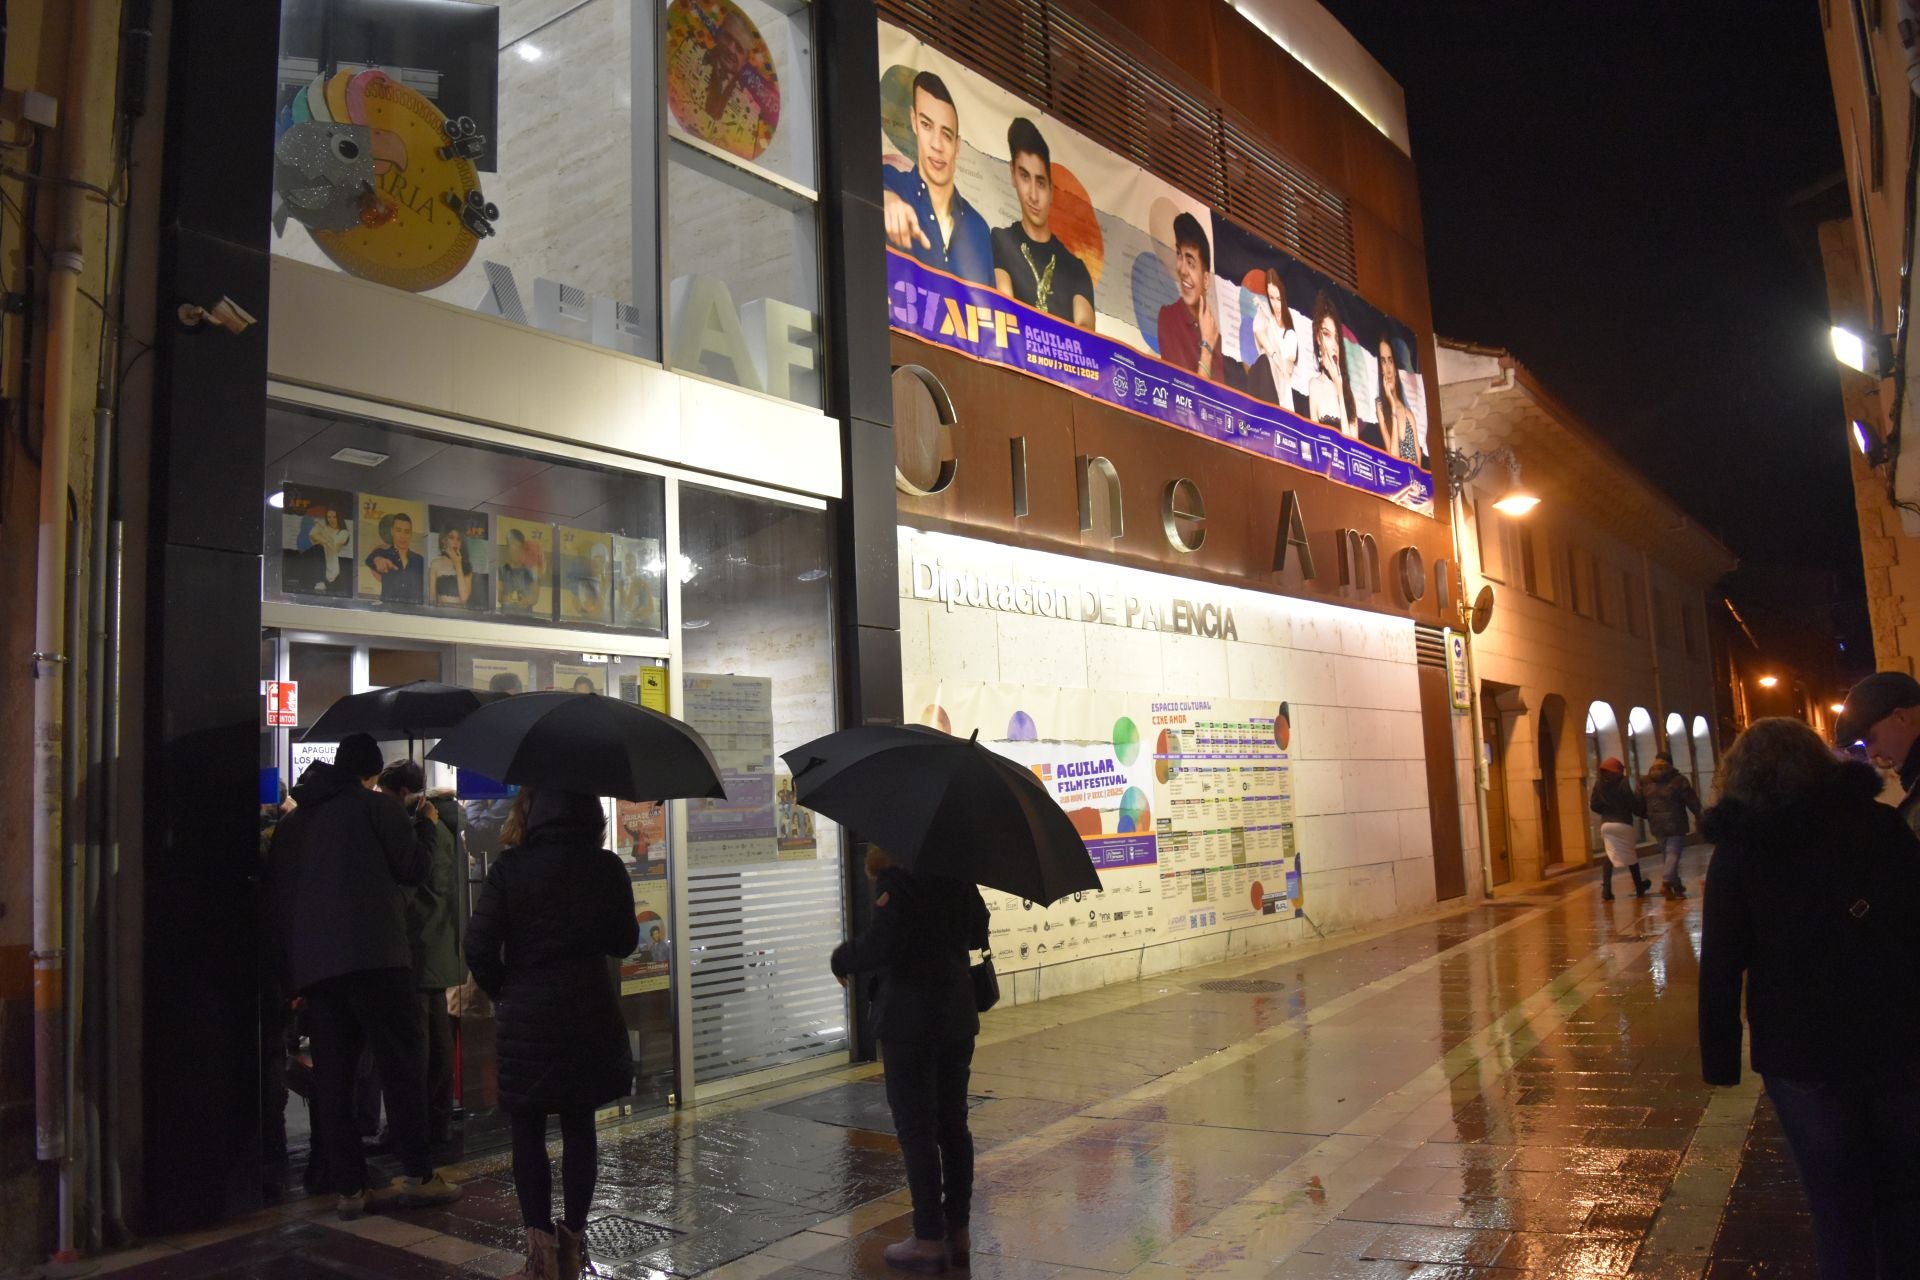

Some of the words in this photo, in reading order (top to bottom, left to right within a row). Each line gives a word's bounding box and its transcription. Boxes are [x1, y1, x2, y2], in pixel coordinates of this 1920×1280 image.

[1025, 325, 1083, 355] AGUILAR
[1026, 339, 1051, 357] FILM
[1052, 347, 1099, 370] FESTIVAL
[1027, 353, 1037, 363] 28
[1038, 356, 1053, 368] NOV
[1081, 368, 1099, 381] 2025
[1113, 376, 1128, 390] GOYA
[890, 364, 1206, 552] Cine
[1272, 489, 1451, 610] Amor
[1079, 583, 1118, 626] DE
[1124, 593, 1239, 641] PALENCIA
[1151, 702, 1179, 712] ESPACIO
[1180, 701, 1211, 711] CULTURAL
[1152, 715, 1168, 725] CINE
[1170, 715, 1187, 724] AMOR
[294, 757, 311, 765] LOS
[1057, 759, 1114, 779] AGUILAR
[1058, 780, 1082, 793] FILM
[1084, 774, 1127, 789] FESTIVAL
